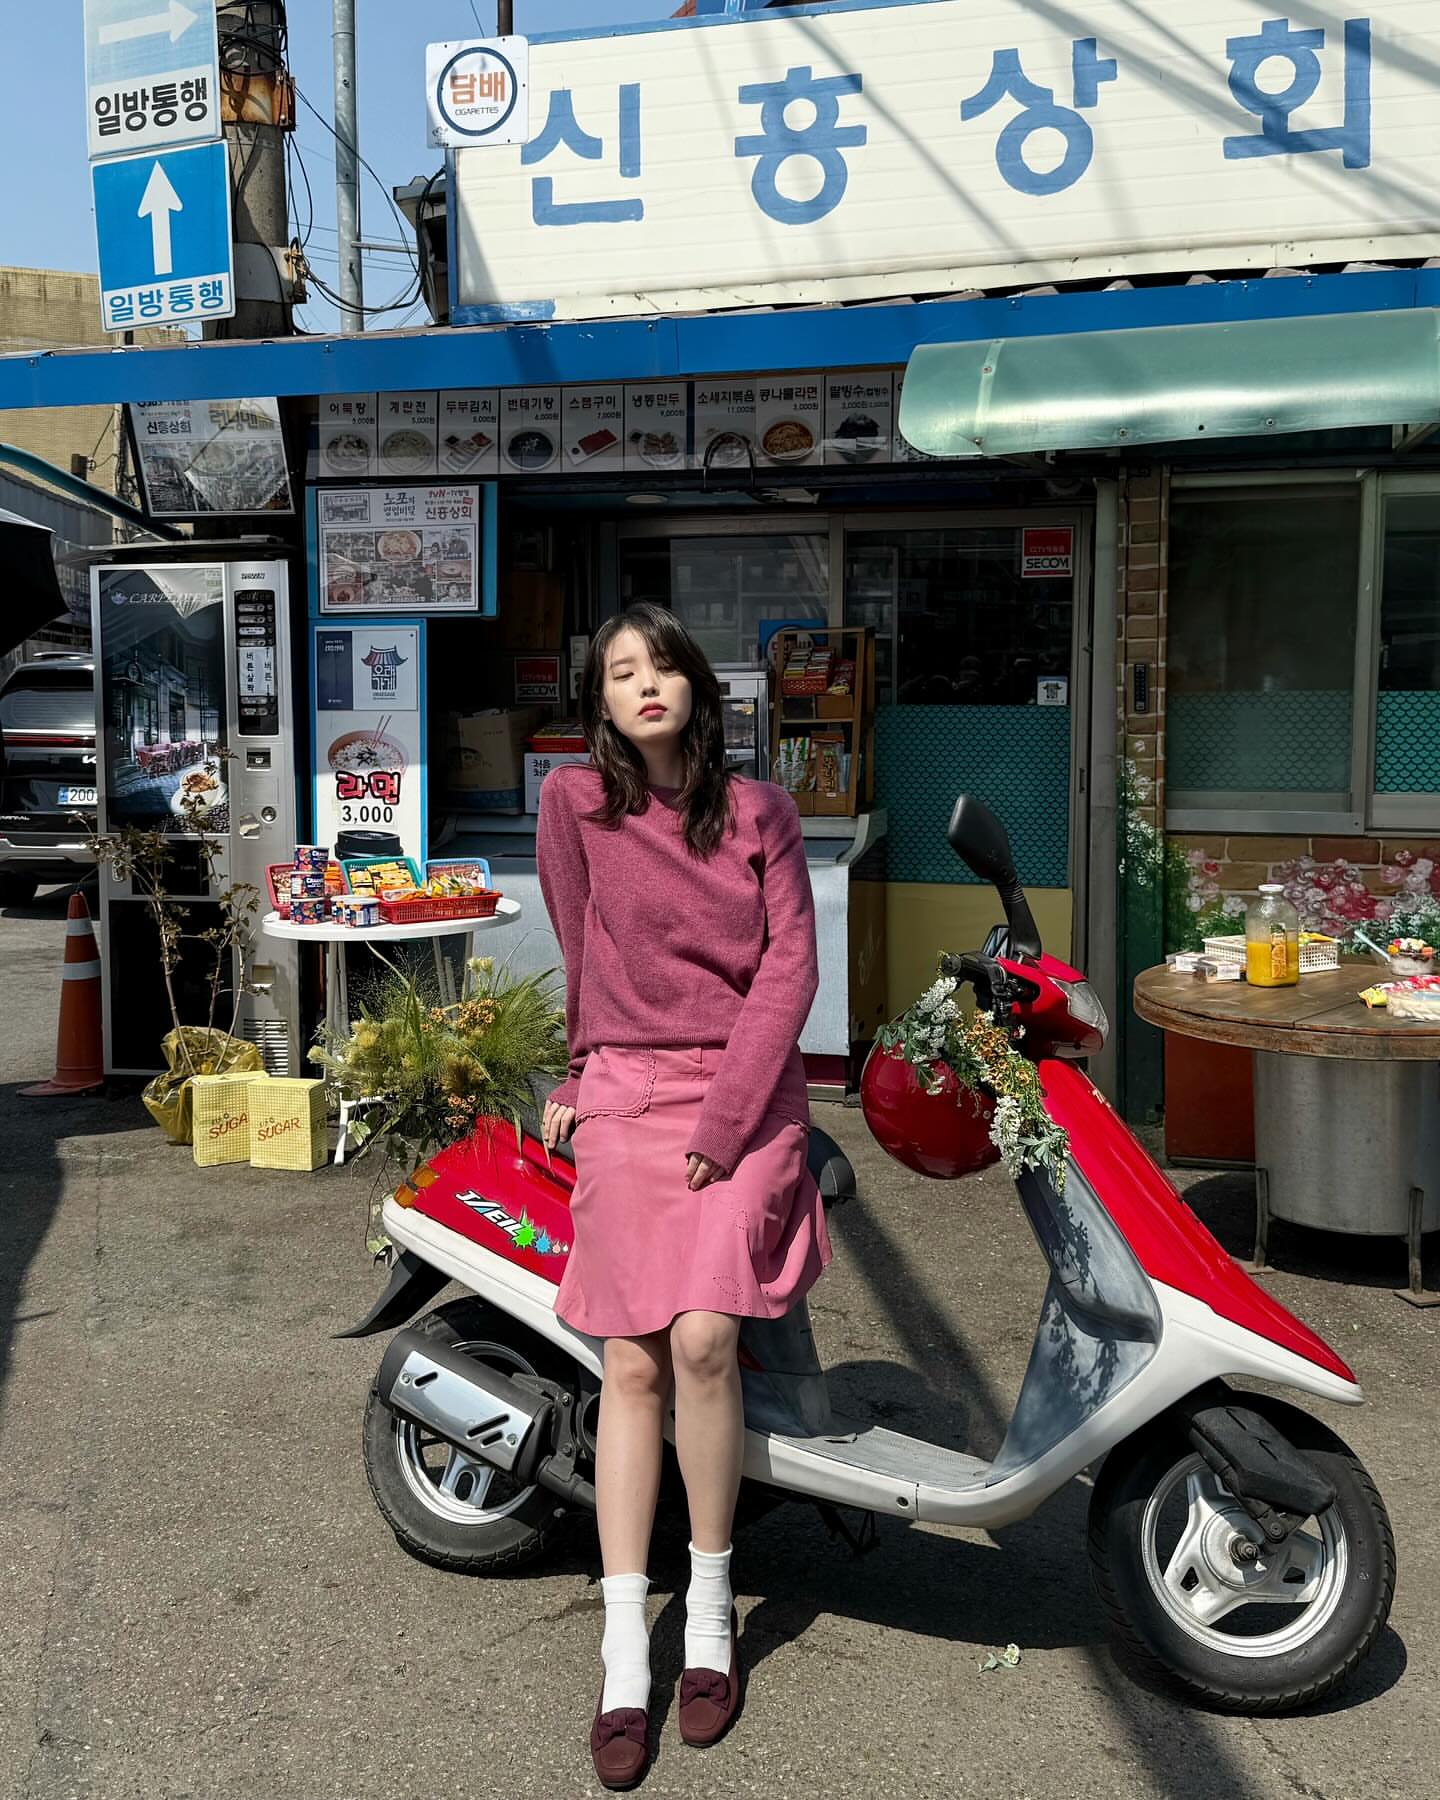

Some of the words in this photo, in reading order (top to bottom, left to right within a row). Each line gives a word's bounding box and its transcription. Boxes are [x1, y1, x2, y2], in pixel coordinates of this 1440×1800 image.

[450, 71, 505, 105] 담배
[94, 77, 208, 137] 일방통행
[455, 107, 499, 116] CIGARETTES
[521, 17, 1372, 227] 신흥상회
[109, 279, 224, 324] 일방통행
[446, 400, 492, 414] 두부김치
[632, 393, 680, 408] 냉동만두
[147, 420, 192, 435] 신흥상회
[425, 505, 472, 521] 신흥상회
[1026, 557, 1069, 569] SECOM
[69, 788, 94, 803] 200
[336, 771, 401, 806] 라면
[342, 805, 393, 824] 3,000
[209, 1112, 248, 1139] SUGA
[258, 1117, 302, 1141] SUGAR
